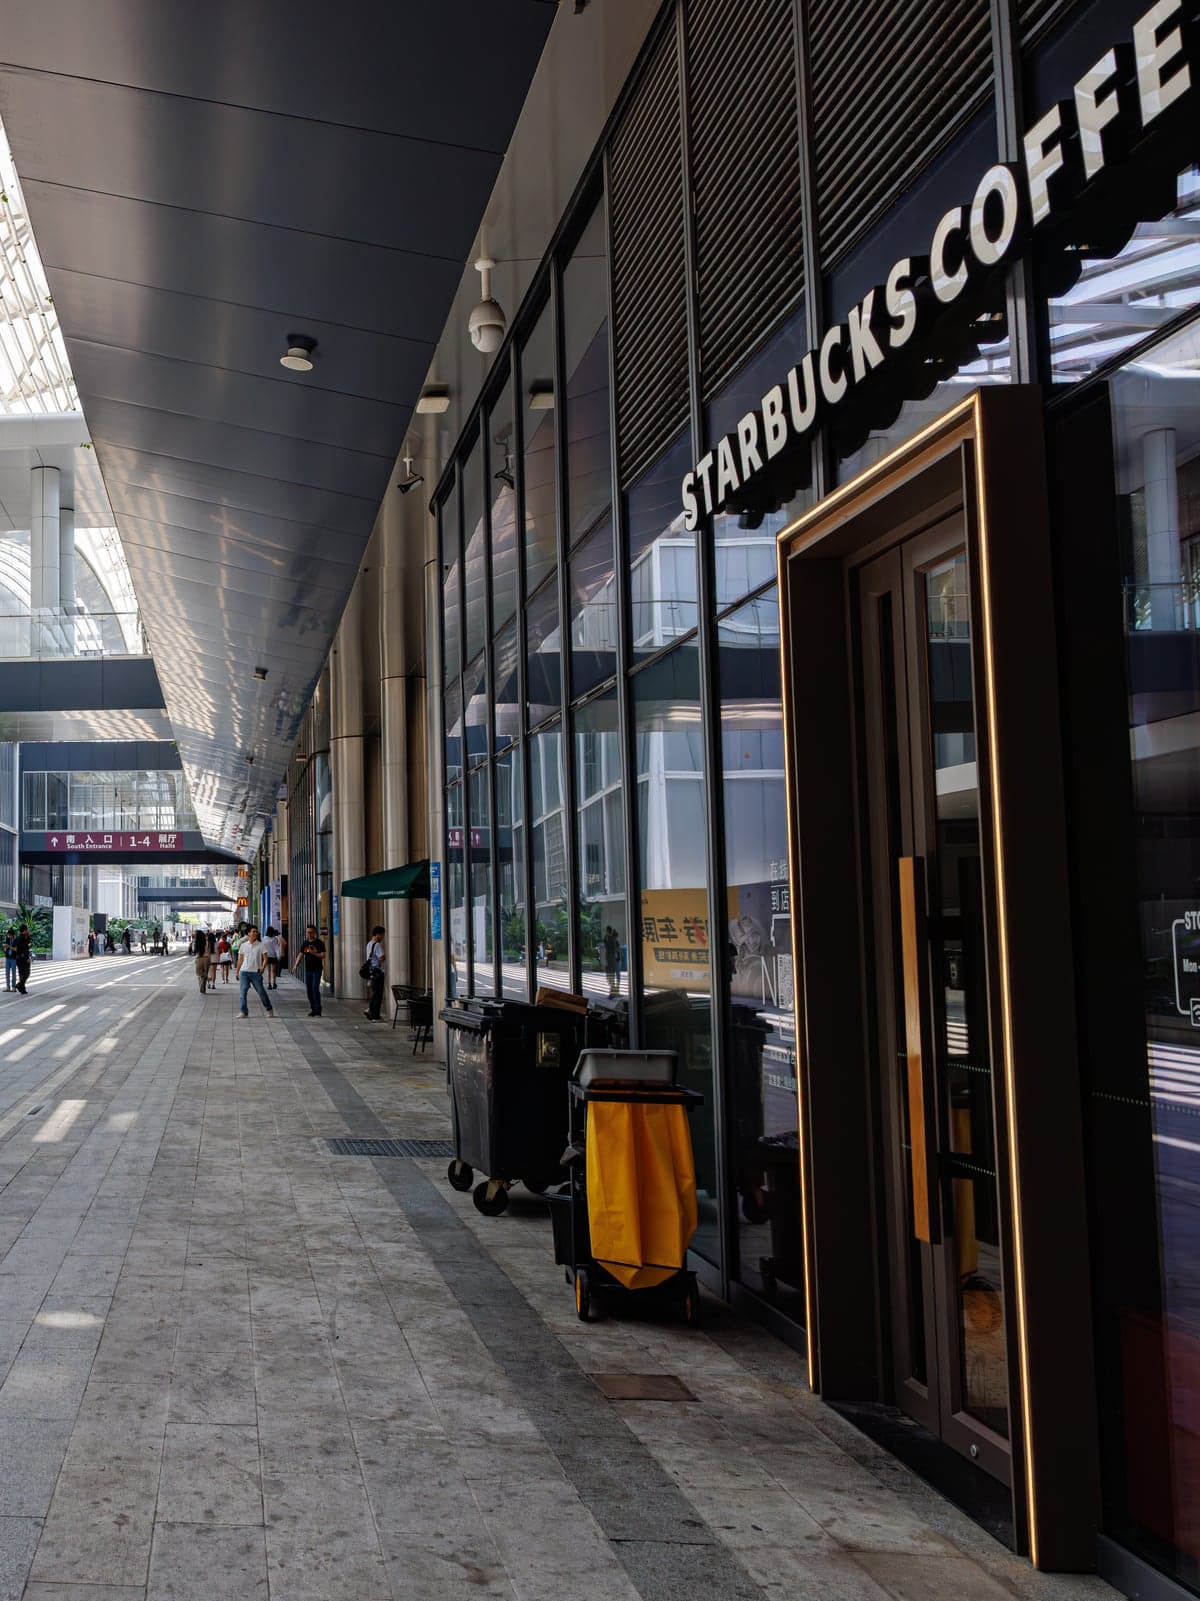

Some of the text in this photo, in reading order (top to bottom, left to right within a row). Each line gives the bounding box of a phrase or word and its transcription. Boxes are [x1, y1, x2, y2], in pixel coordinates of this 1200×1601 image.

[681, 0, 1192, 531] STARBUCKS COFFE
[66, 835, 113, 843] 南入口
[129, 836, 151, 847] 1-4
[158, 834, 177, 843] 展厅
